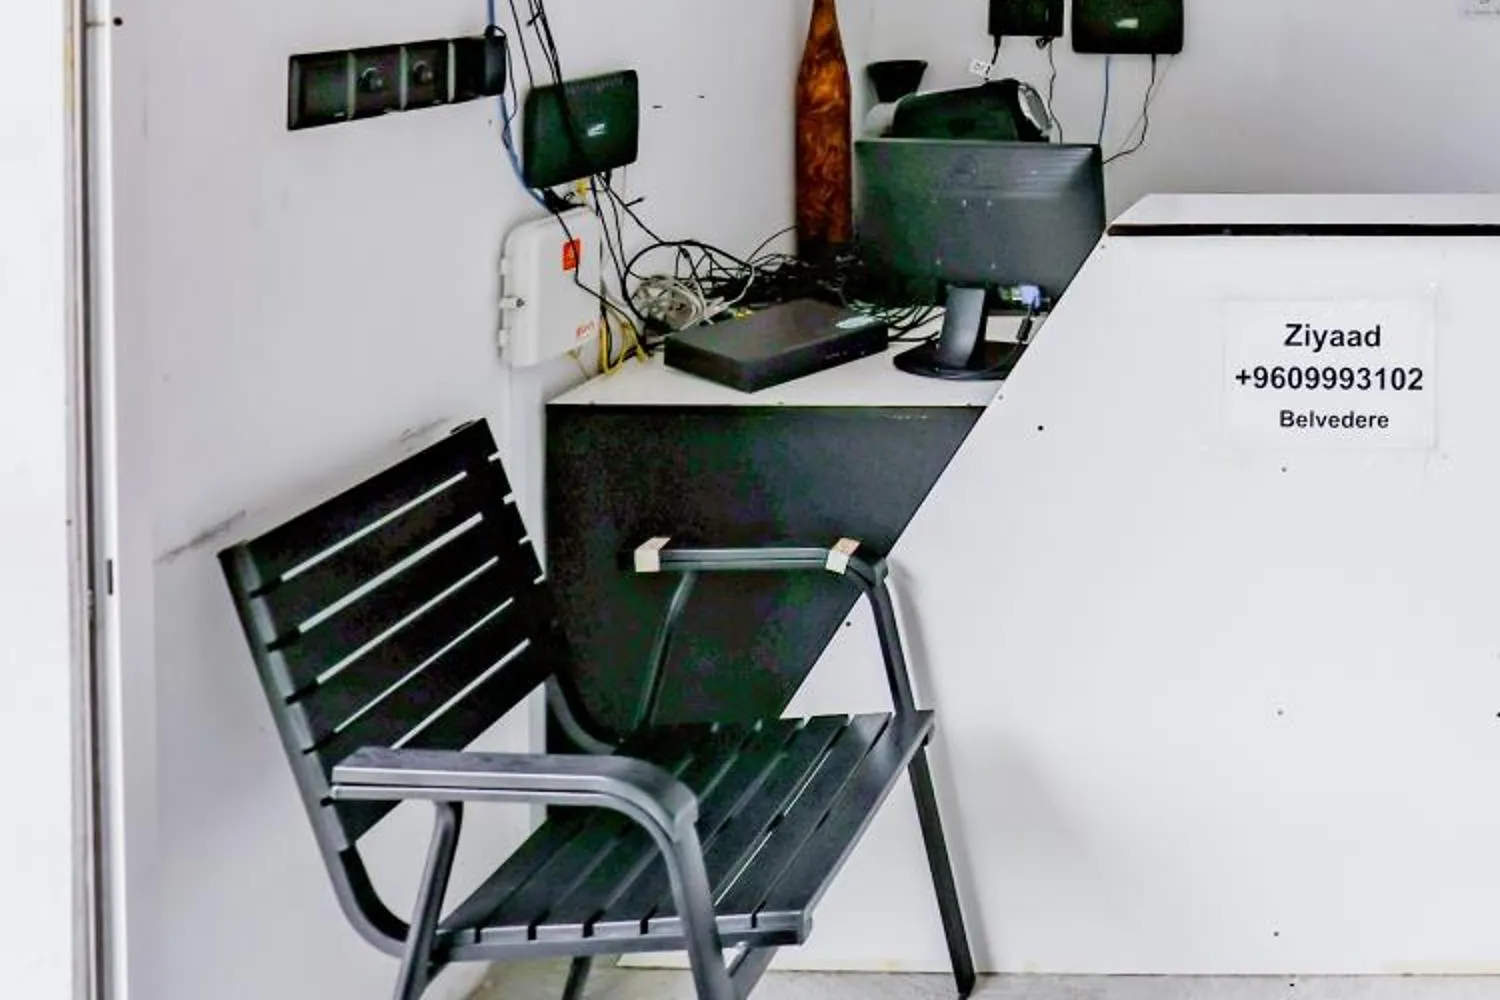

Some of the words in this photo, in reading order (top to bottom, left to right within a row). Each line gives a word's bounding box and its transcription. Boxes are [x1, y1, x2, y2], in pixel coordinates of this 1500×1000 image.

[1284, 323, 1381, 352] Ziyaad
[1235, 366, 1424, 391] +9609993102
[1279, 410, 1389, 429] Belvedere
